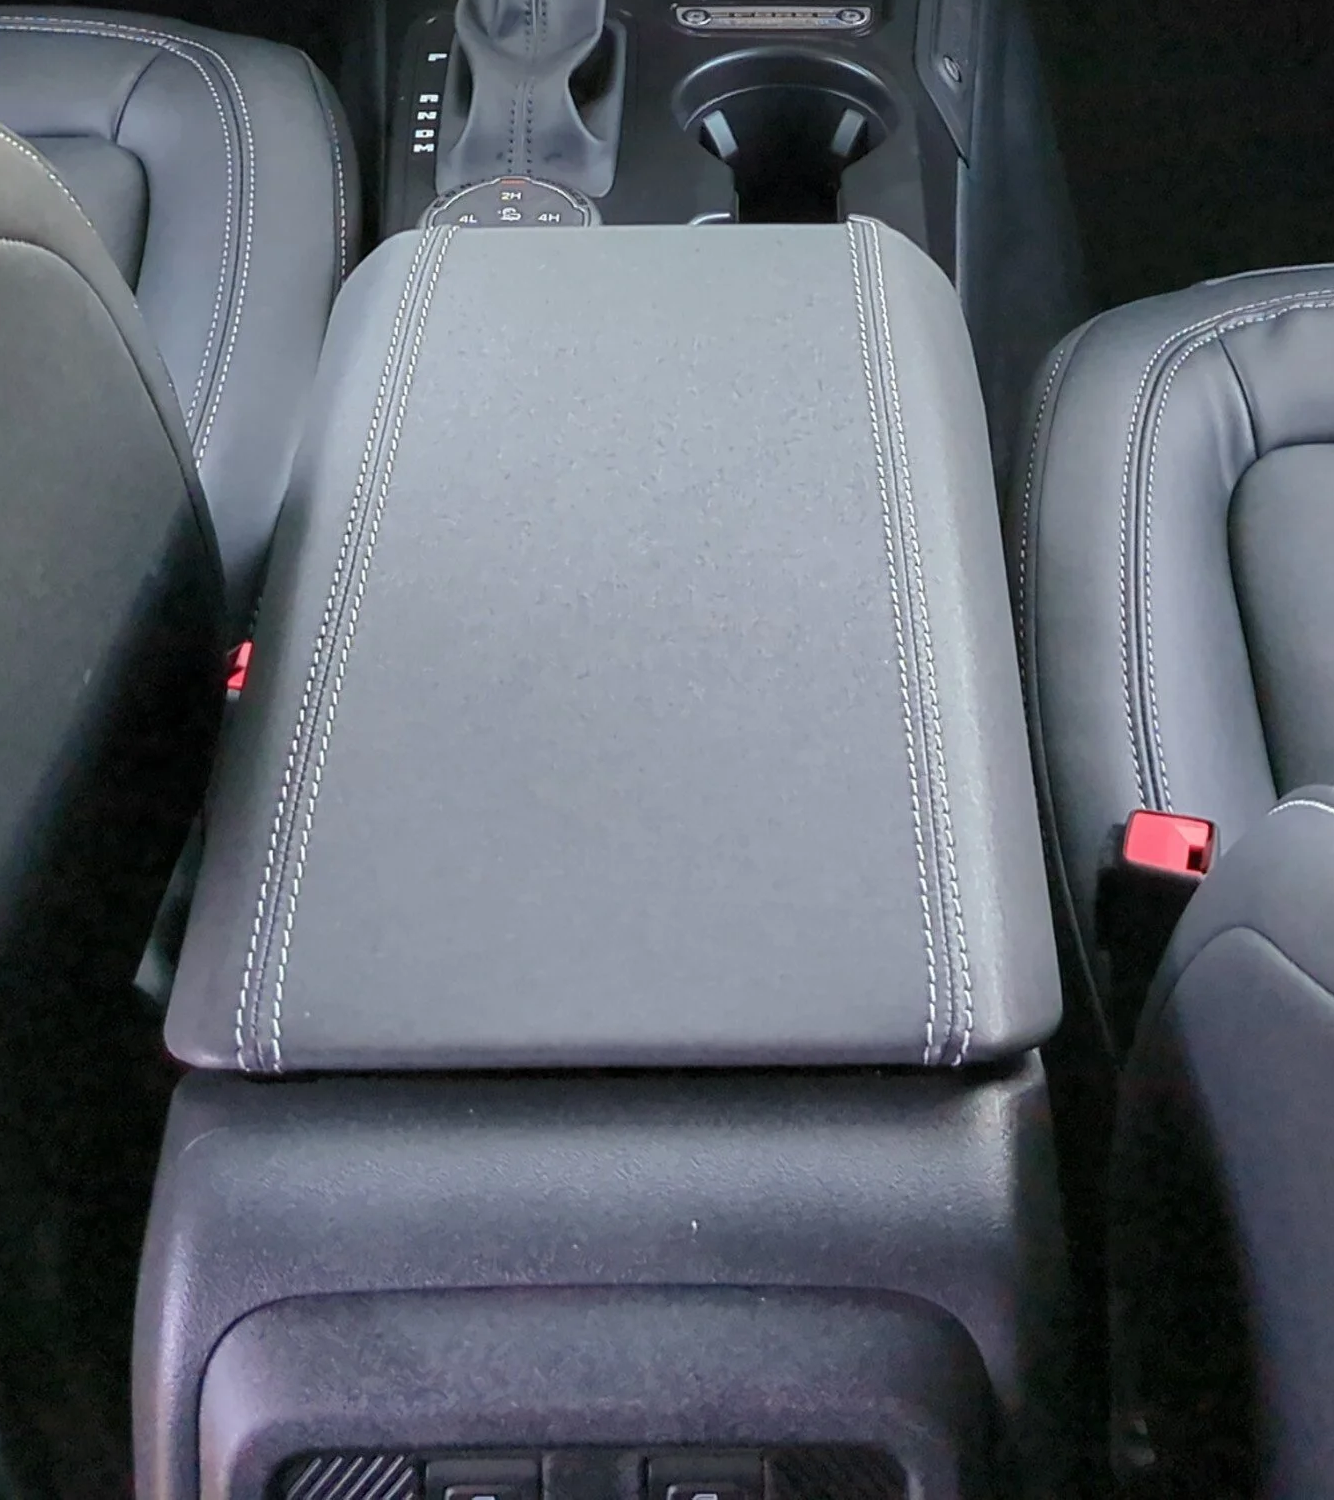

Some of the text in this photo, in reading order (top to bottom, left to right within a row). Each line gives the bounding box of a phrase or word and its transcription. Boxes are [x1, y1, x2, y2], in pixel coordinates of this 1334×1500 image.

[417, 111, 437, 120] N
[413, 143, 435, 153] M
[501, 192, 522, 200] 2H
[459, 214, 478, 223] 4L
[538, 213, 560, 222] 4H
